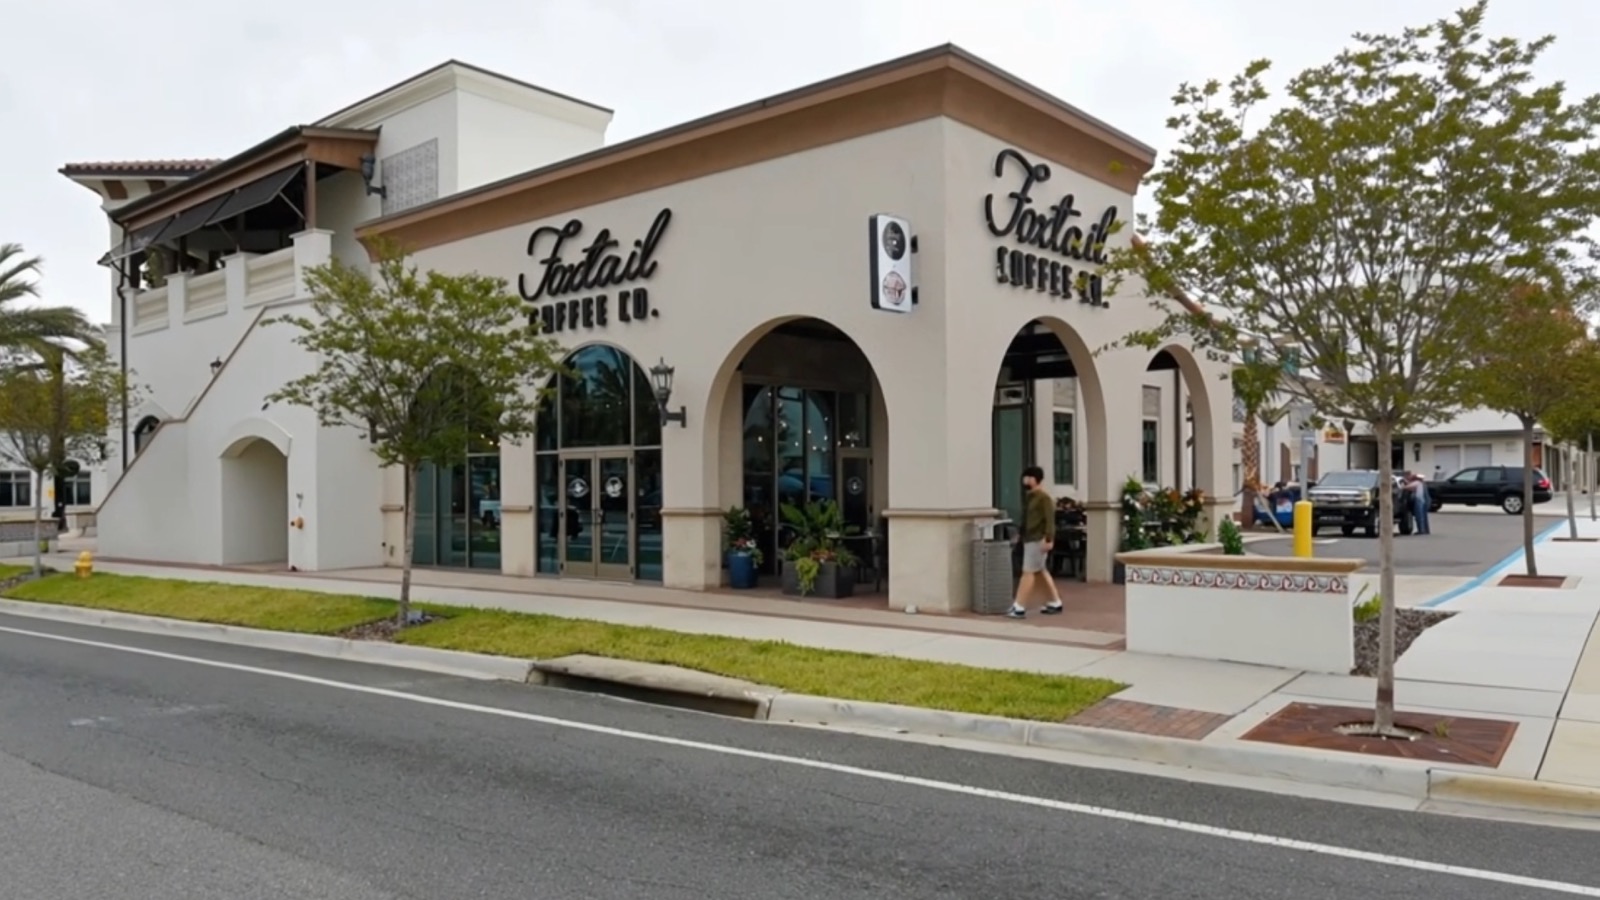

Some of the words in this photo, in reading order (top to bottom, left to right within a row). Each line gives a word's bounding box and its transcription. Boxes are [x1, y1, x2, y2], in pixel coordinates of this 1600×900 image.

[985, 148, 1117, 265] Foxtail
[518, 207, 672, 301] Foxtail
[997, 245, 1073, 300] COFFEE
[618, 287, 660, 323] CO.
